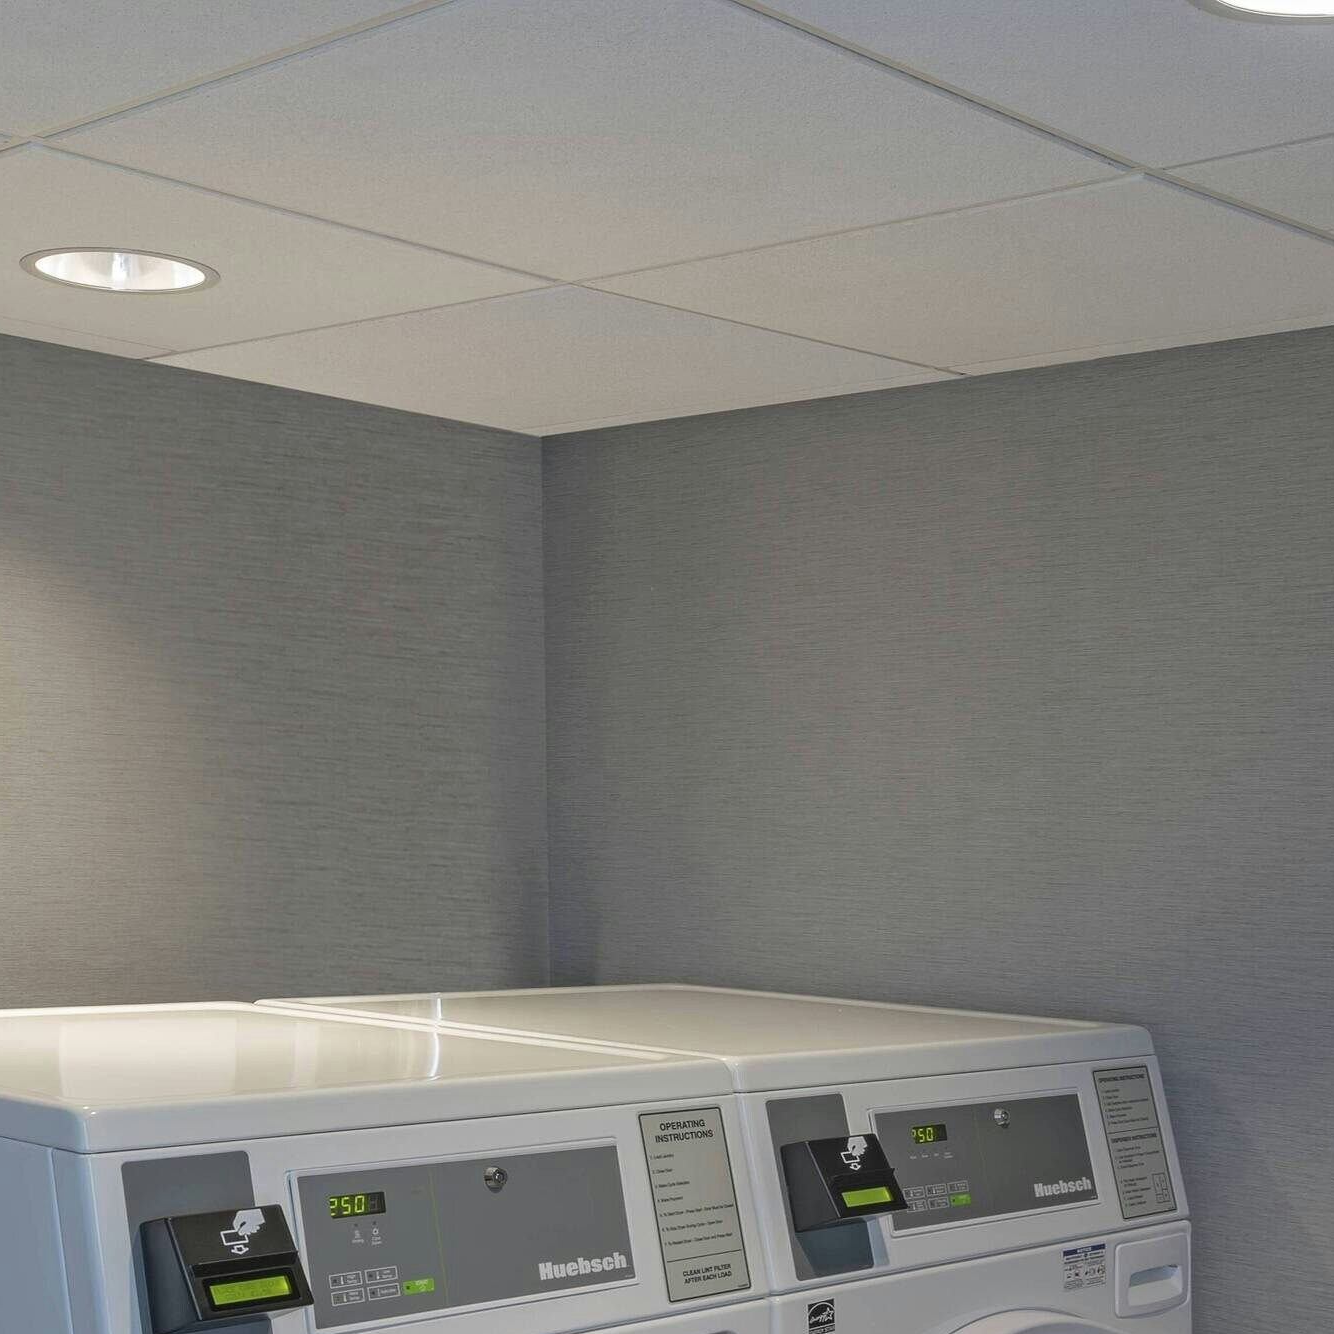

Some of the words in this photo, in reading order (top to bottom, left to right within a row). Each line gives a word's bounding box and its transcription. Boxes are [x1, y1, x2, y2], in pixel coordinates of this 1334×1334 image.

[659, 1119, 705, 1131] OPERATING
[655, 1130, 714, 1143] INSTRUCTIONS
[1033, 1176, 1092, 1198] Huebsch
[538, 1251, 627, 1281] Huebsch
[682, 1268, 701, 1277] CLEAN
[714, 1263, 732, 1272] FILTER
[684, 1276, 702, 1284] AFTER
[703, 1273, 717, 1281] EACH
[718, 1270, 733, 1279] LOAD
